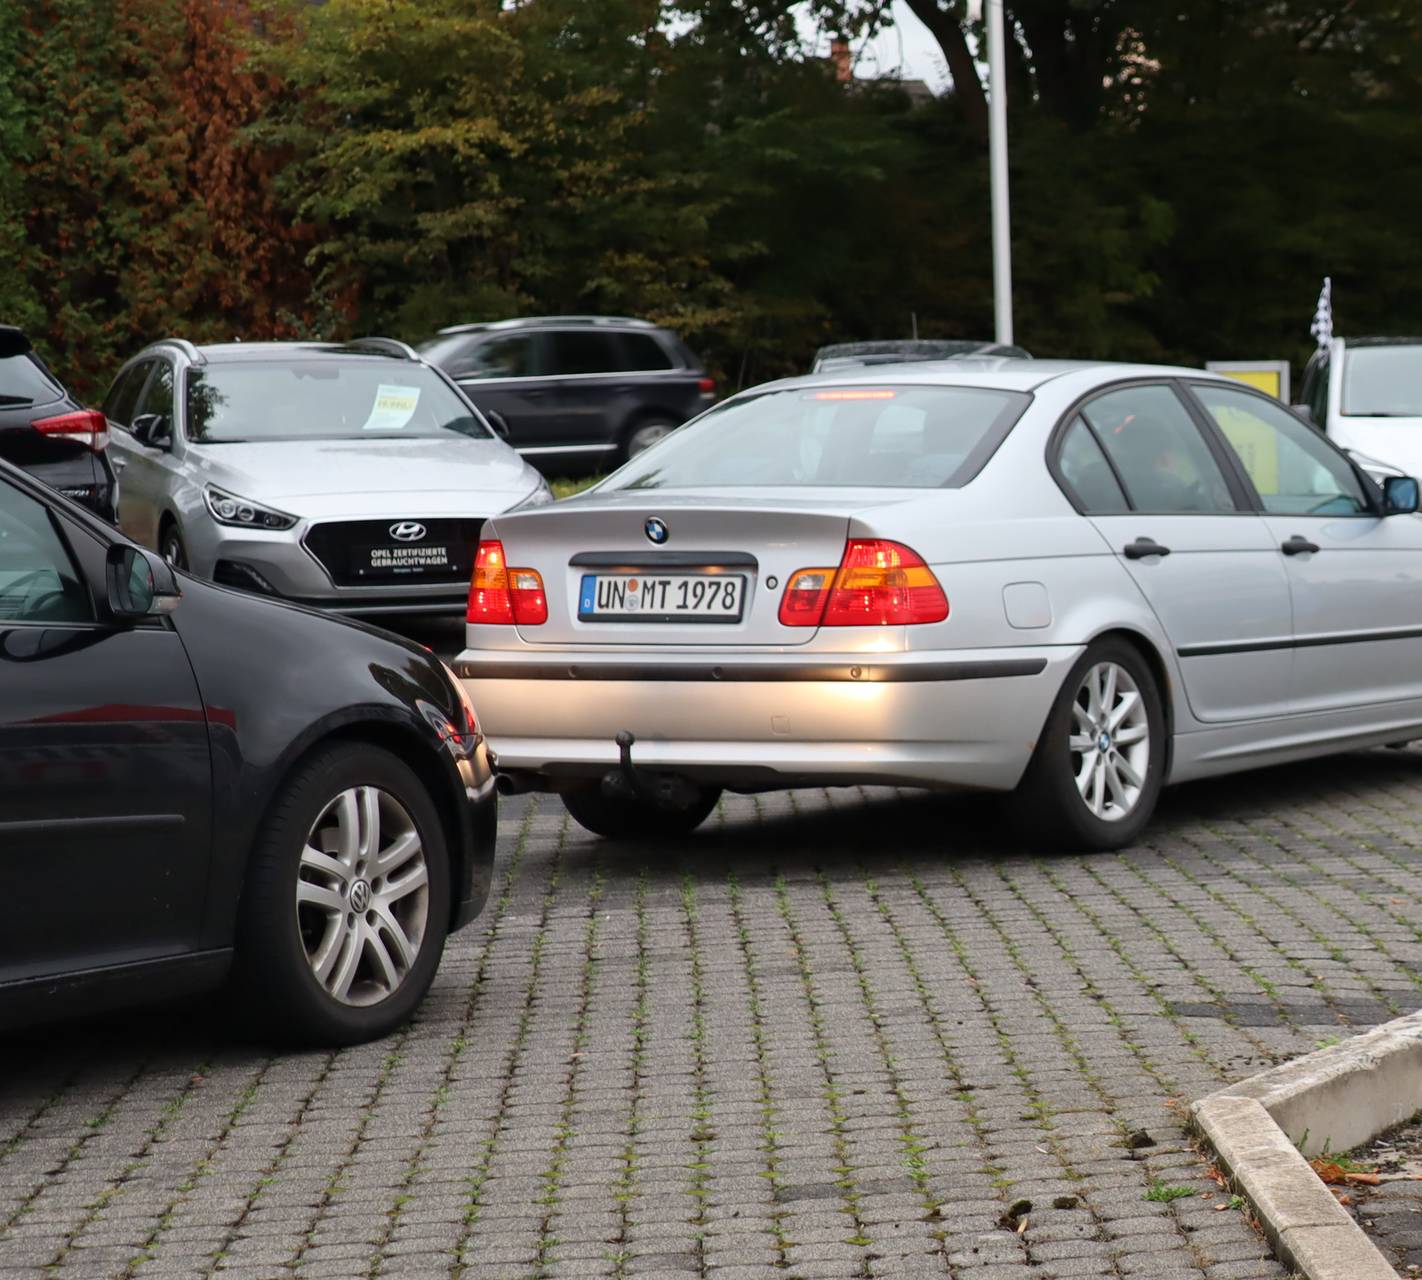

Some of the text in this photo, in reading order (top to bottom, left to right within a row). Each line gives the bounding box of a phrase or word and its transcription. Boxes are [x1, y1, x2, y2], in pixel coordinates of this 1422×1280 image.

[393, 547, 446, 556] ZERTIFIZIERTE
[371, 556, 447, 567] GEBRAUCHTWAGEN
[597, 580, 736, 610] UN MT 1978
